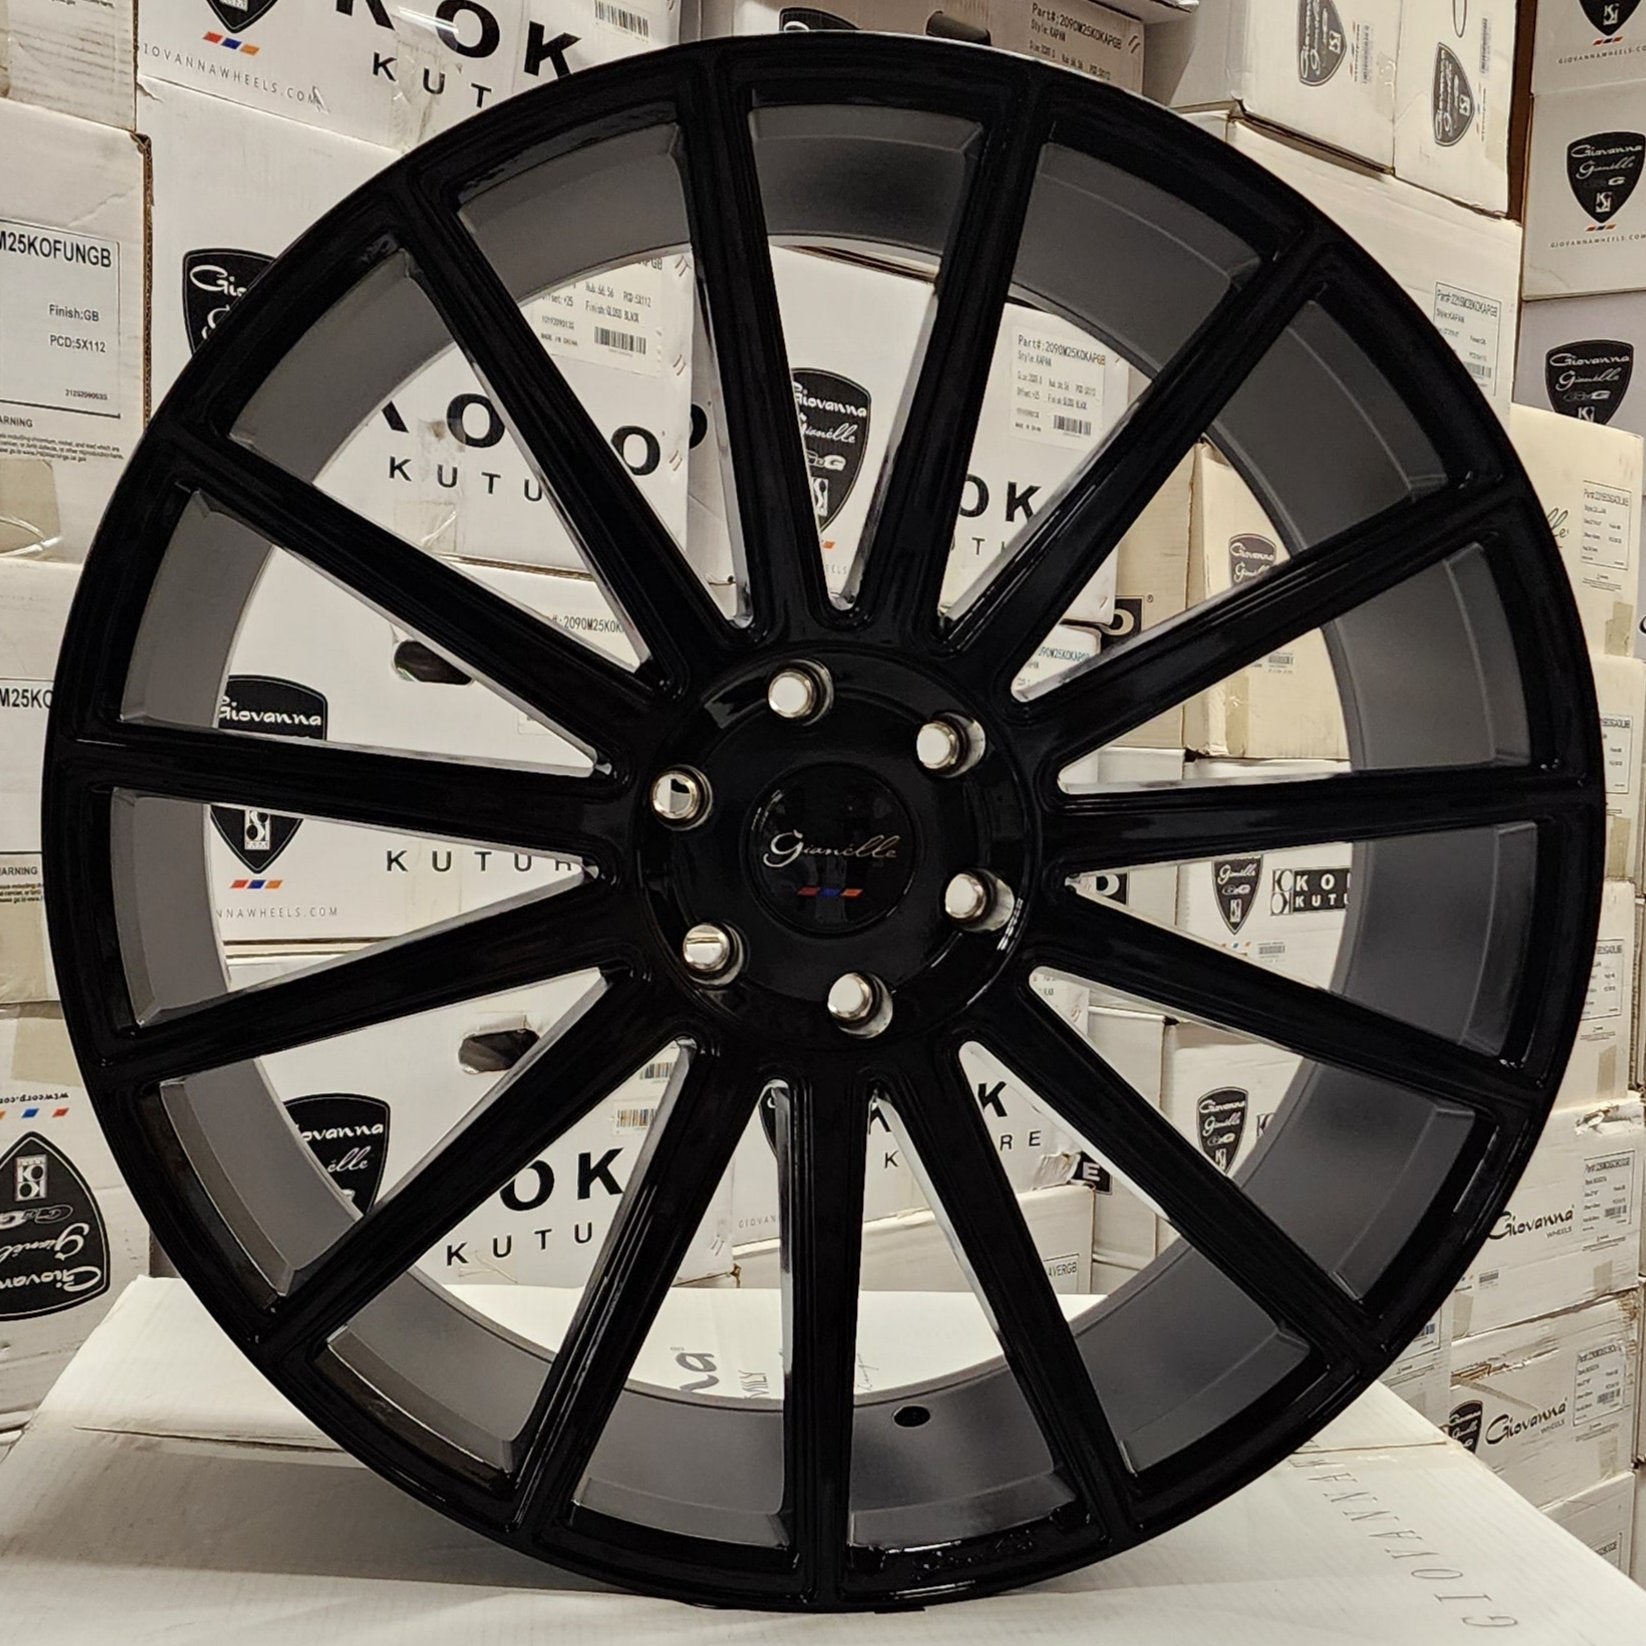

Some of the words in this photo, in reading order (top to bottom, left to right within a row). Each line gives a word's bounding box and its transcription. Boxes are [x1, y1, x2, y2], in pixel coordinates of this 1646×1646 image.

[1571, 144, 1643, 158] Giovanna
[49, 304, 100, 322] Finish:GB
[50, 335, 106, 353] PCD:5X112
[1549, 352, 1631, 367] Giovanna
[0, 866, 39, 876] ARNING
[1295, 873, 1351, 893] KO
[1486, 1401, 1567, 1445] Giovanna
